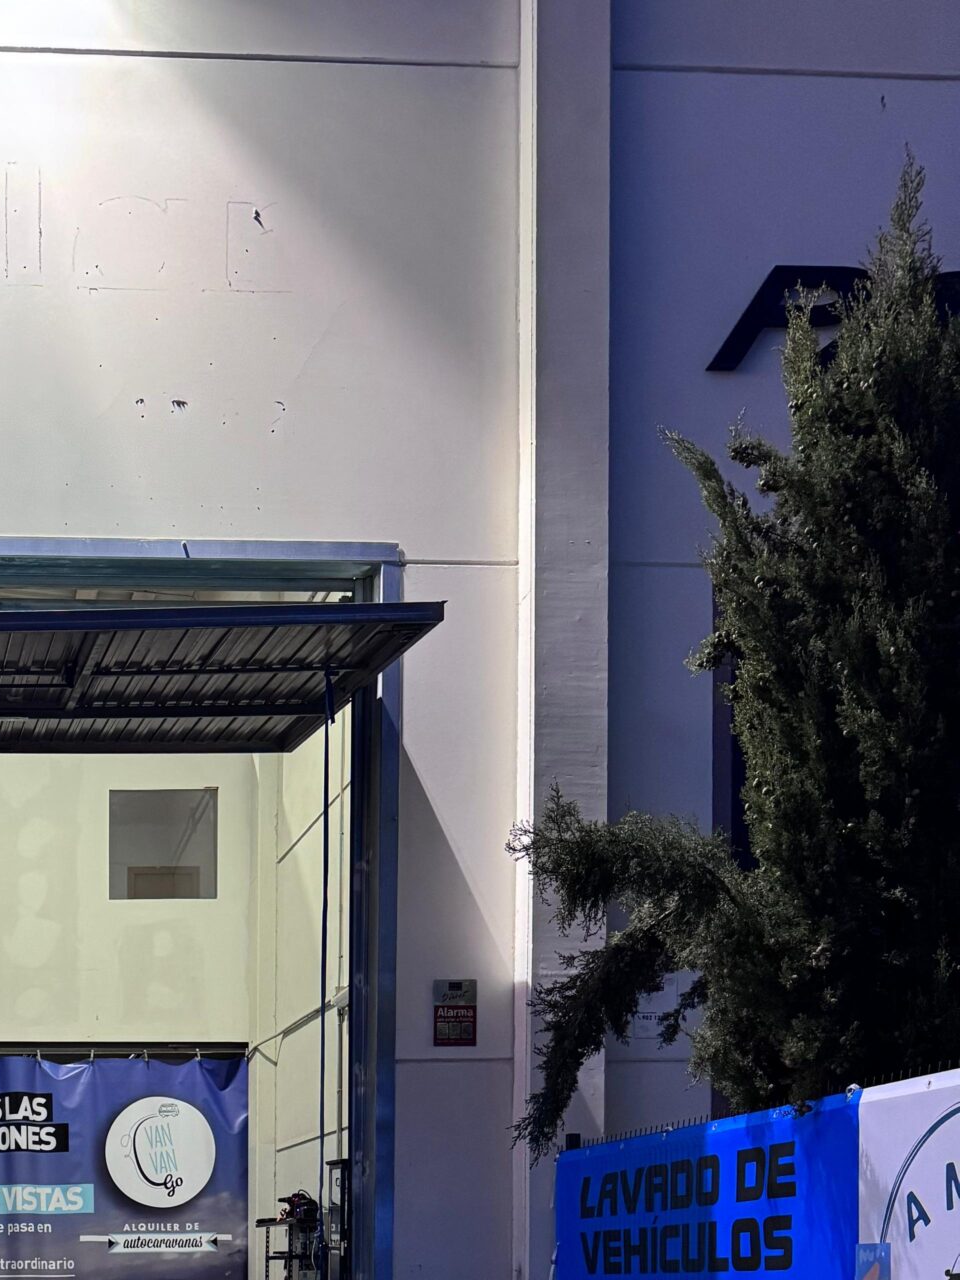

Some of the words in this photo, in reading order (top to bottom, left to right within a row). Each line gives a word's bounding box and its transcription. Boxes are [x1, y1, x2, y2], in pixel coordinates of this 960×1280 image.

[436, 1007, 474, 1017] Alarma
[5, 1095, 48, 1121] LAS
[144, 1122, 173, 1149] VAN
[149, 1149, 178, 1175] VAN
[163, 1173, 184, 1197] Go
[580, 1154, 720, 1219] LAVADO
[736, 1141, 796, 1202] DE
[2, 1186, 84, 1212] VISTAS
[7, 1222, 35, 1235] pasa
[37, 1223, 52, 1233] en
[123, 1223, 180, 1232] ALQUILER
[186, 1222, 200, 1231] DE
[905, 1190, 931, 1243] A
[123, 1235, 203, 1249] autocaravanas
[580, 1214, 793, 1275] VEHÍCULOS
